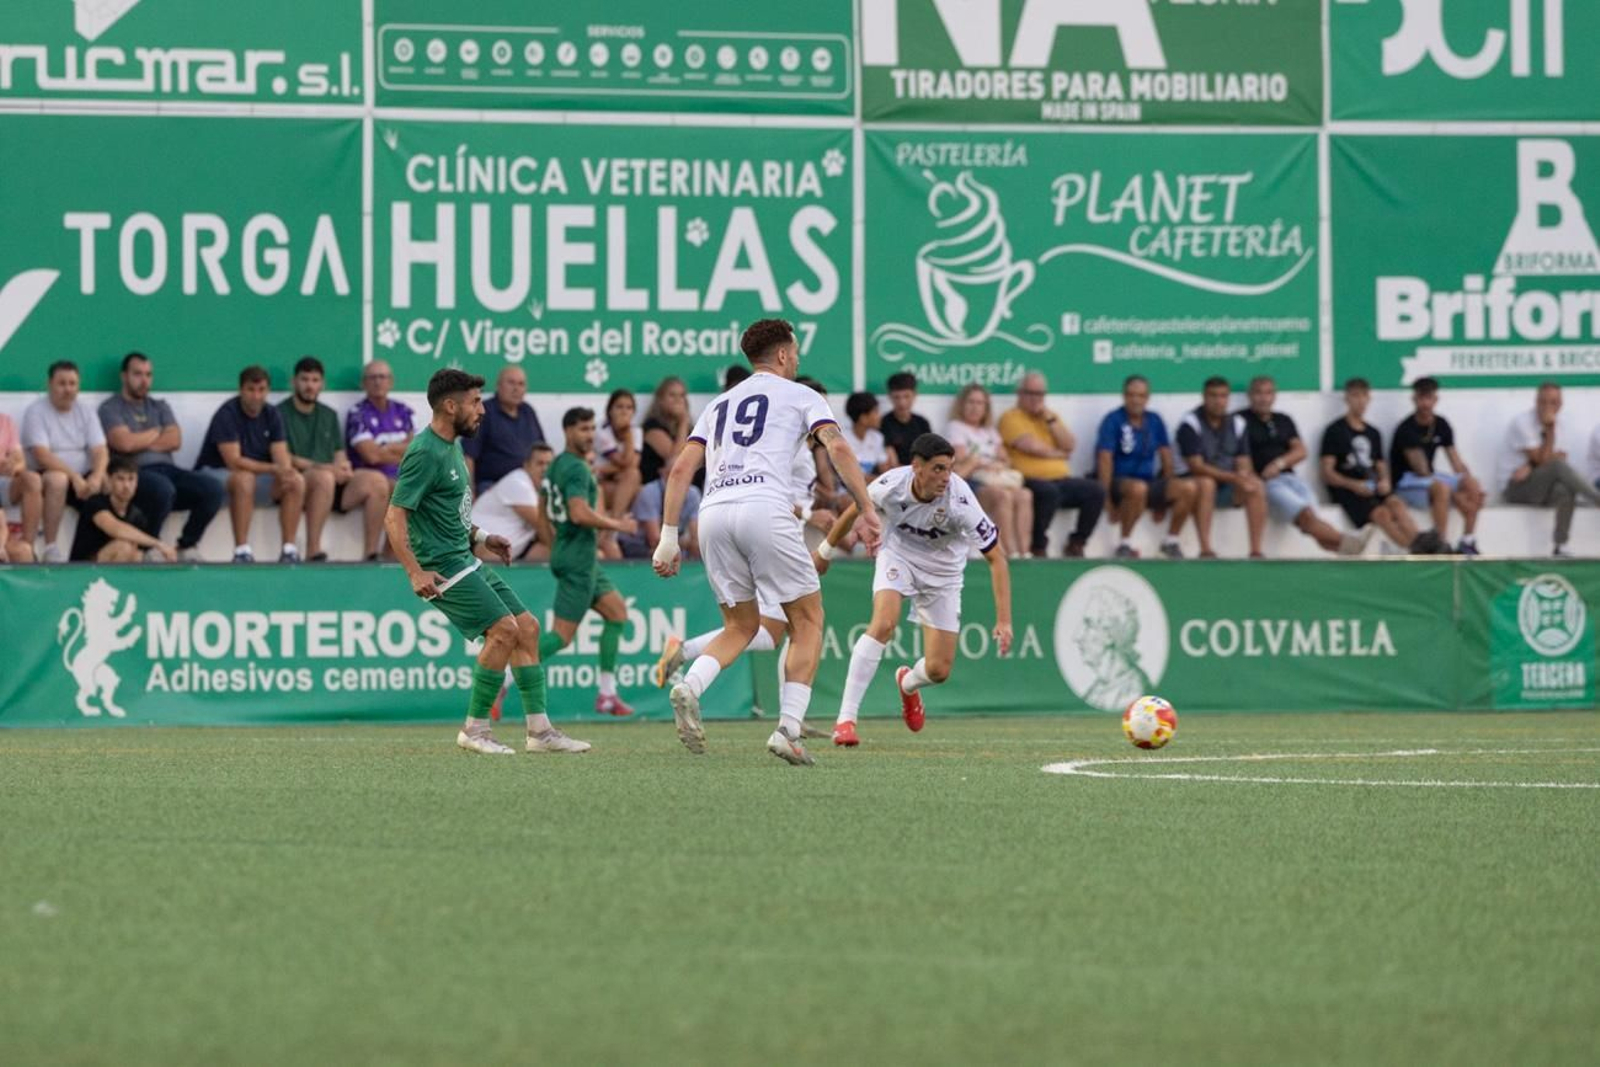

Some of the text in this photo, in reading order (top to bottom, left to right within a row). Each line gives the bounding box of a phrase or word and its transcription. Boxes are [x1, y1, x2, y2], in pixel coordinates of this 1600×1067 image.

[890, 69, 1288, 102] TIRADORES PARA MOBILIARIO
[1041, 102, 1141, 121] MADE IN SPAIN
[406, 144, 824, 197] CLÍNICA VETERINARIA
[897, 140, 1027, 168] PASTELERÍA
[1051, 170, 1254, 226] PLANET
[391, 201, 840, 314] HUELLAS
[1129, 219, 1304, 261] CAFETERÍA
[1504, 252, 1597, 271] BRIFORMA
[407, 319, 450, 359] C/
[460, 320, 569, 362] Virgen
[579, 320, 632, 356] del
[643, 322, 741, 356] Rosari
[713, 394, 769, 450] 19
[147, 610, 451, 658] MORTEROS
[1180, 619, 1397, 657] COLVMELA
[146, 663, 313, 692] Adhesivos
[324, 663, 473, 691] cementos
